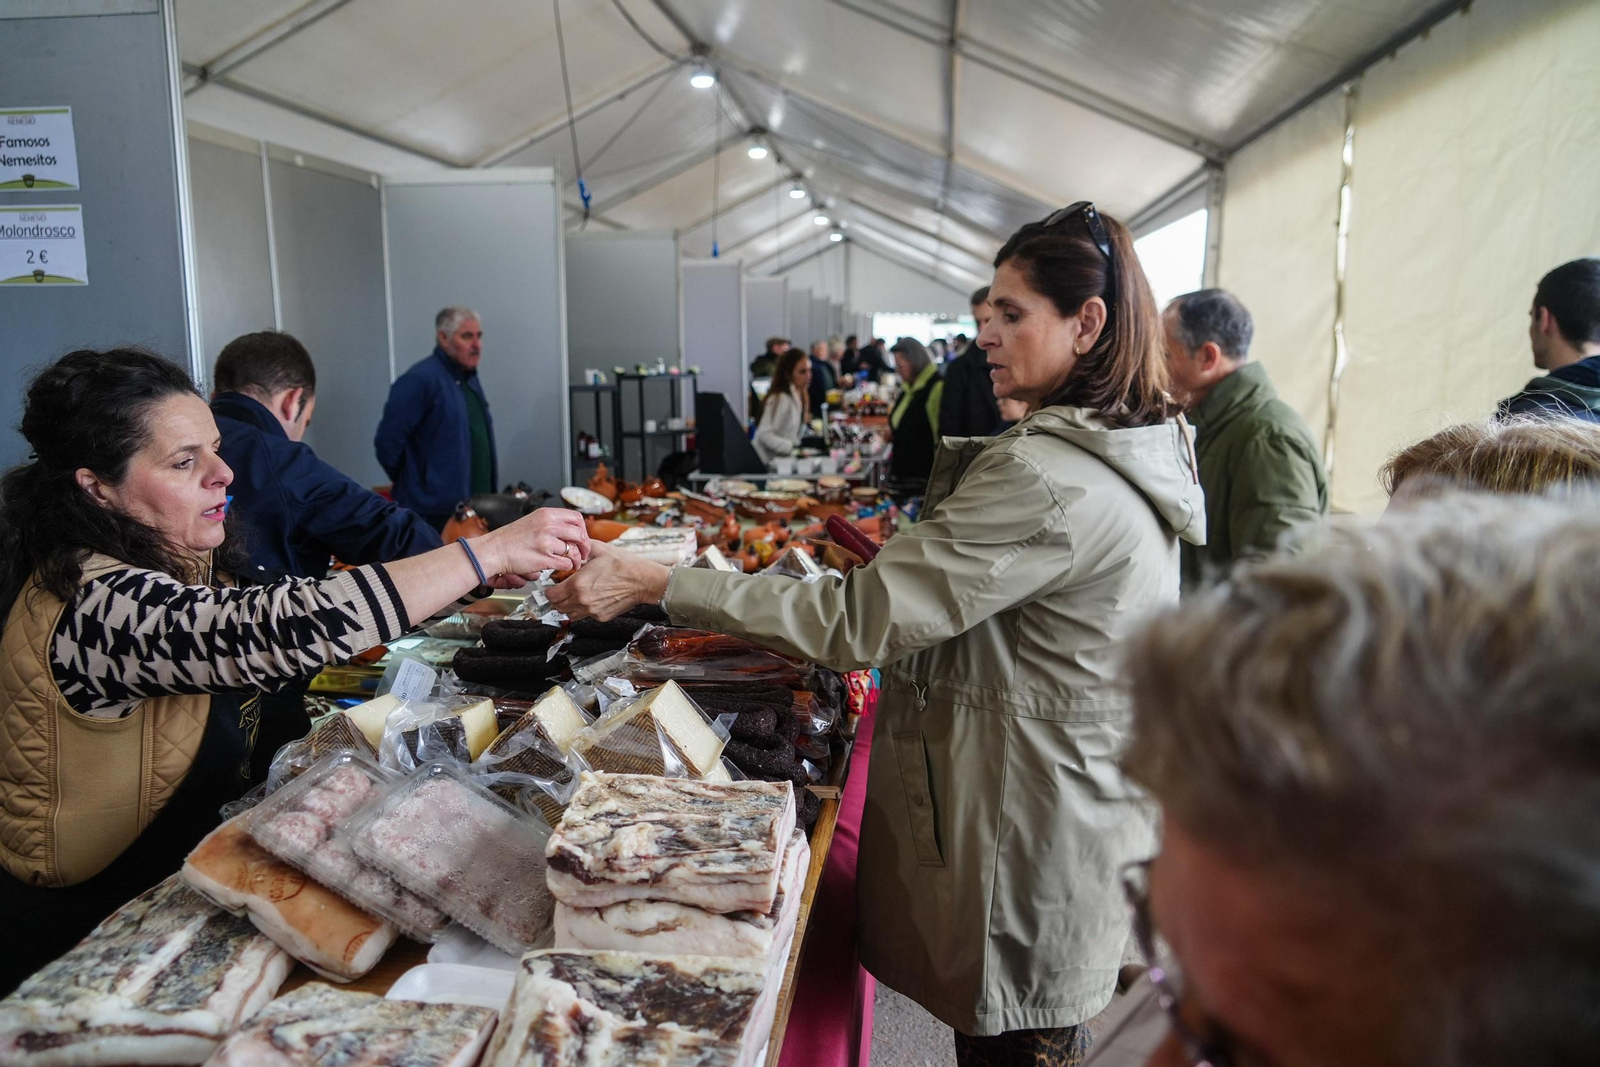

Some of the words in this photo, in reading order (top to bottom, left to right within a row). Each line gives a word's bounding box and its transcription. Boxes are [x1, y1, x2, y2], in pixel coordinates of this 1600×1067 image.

[0, 135, 50, 148] Famosos
[26, 249, 35, 264] 2
[39, 249, 48, 264] €
